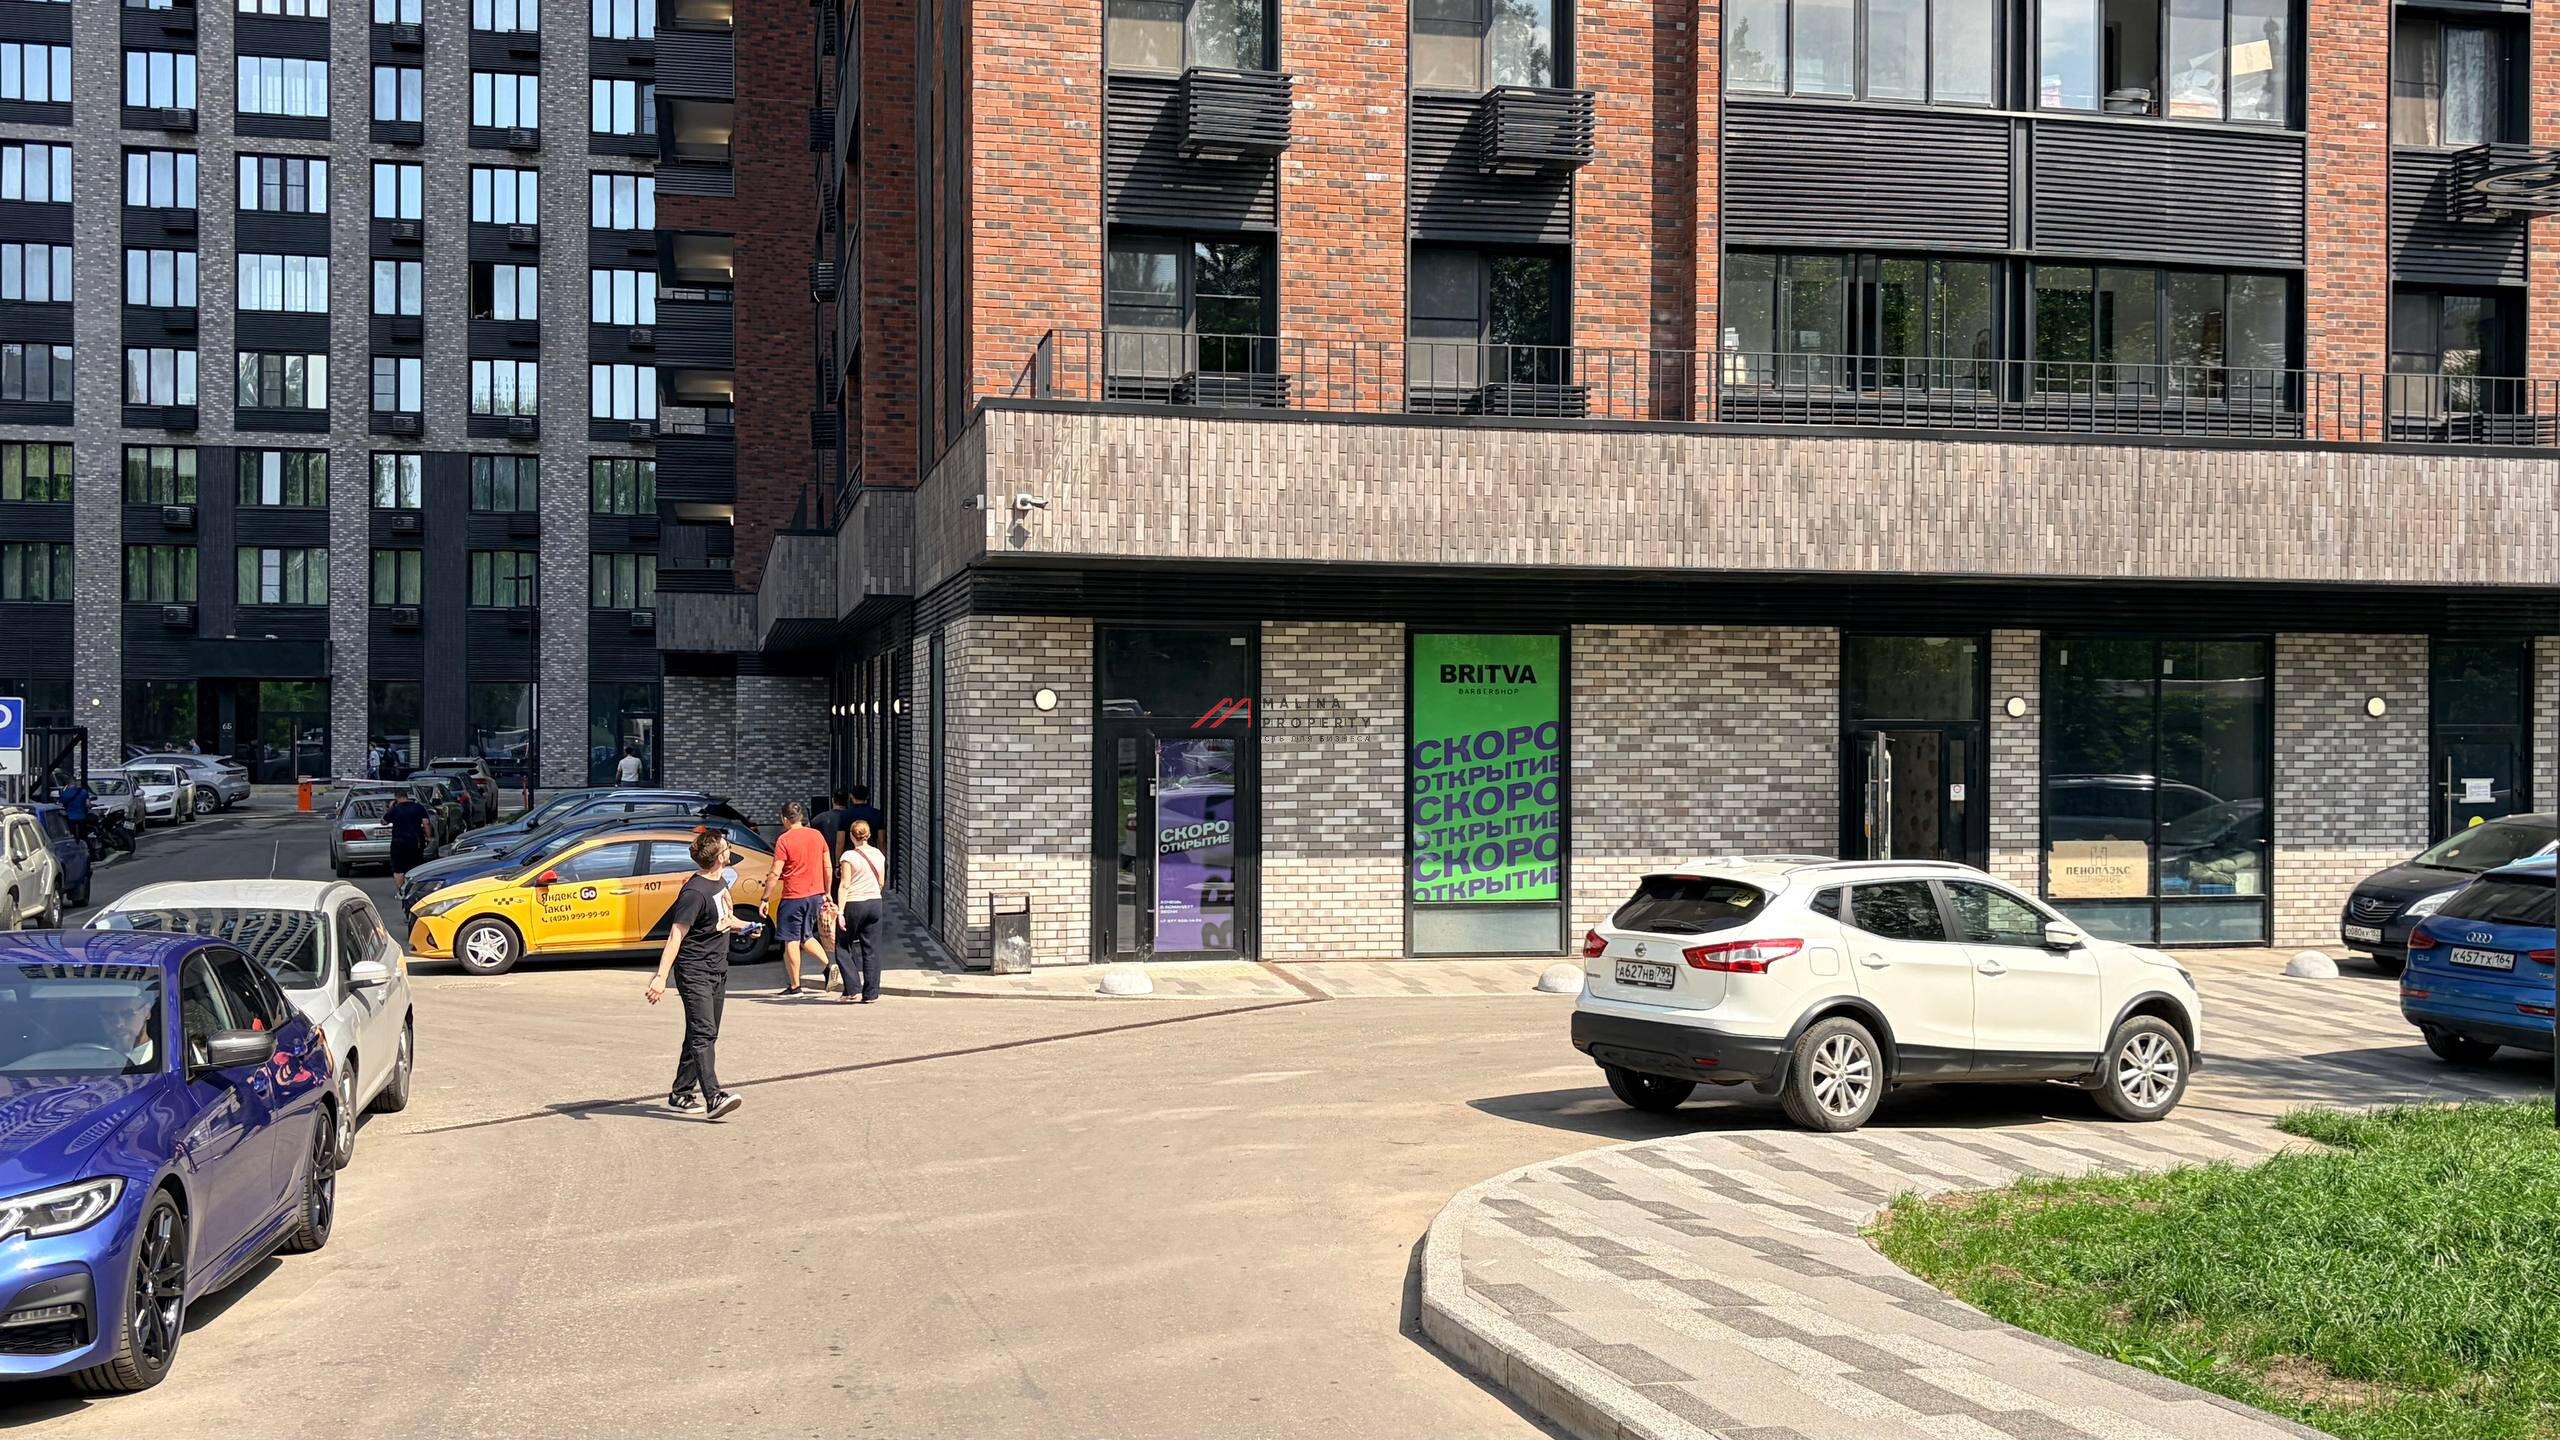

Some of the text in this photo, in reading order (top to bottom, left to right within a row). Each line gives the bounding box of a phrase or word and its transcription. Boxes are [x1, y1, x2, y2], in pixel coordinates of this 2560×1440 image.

[1440, 664, 1537, 684] BRITVA
[1414, 721, 1560, 770] СКОРО
[1414, 754, 1560, 794] ОТКРЫТИЕ
[1414, 776, 1560, 826] СКОРО
[1160, 820, 1230, 843] СКОРО
[1414, 810, 1560, 850] ОТКРЫТИЕ
[1160, 834, 1230, 854] ОТКРЫТИЕ
[1414, 832, 1560, 882] СКОРО
[2065, 866, 2130, 875] ПЕНОПЛЭКС
[644, 881, 662, 891] 407
[1414, 866, 1560, 902] ОТКРЫТИЕ
[541, 888, 596, 902] Яндекс Go
[544, 904, 572, 914] Такси
[2495, 954, 2511, 965] 164
[1656, 965, 1671, 977] 799
